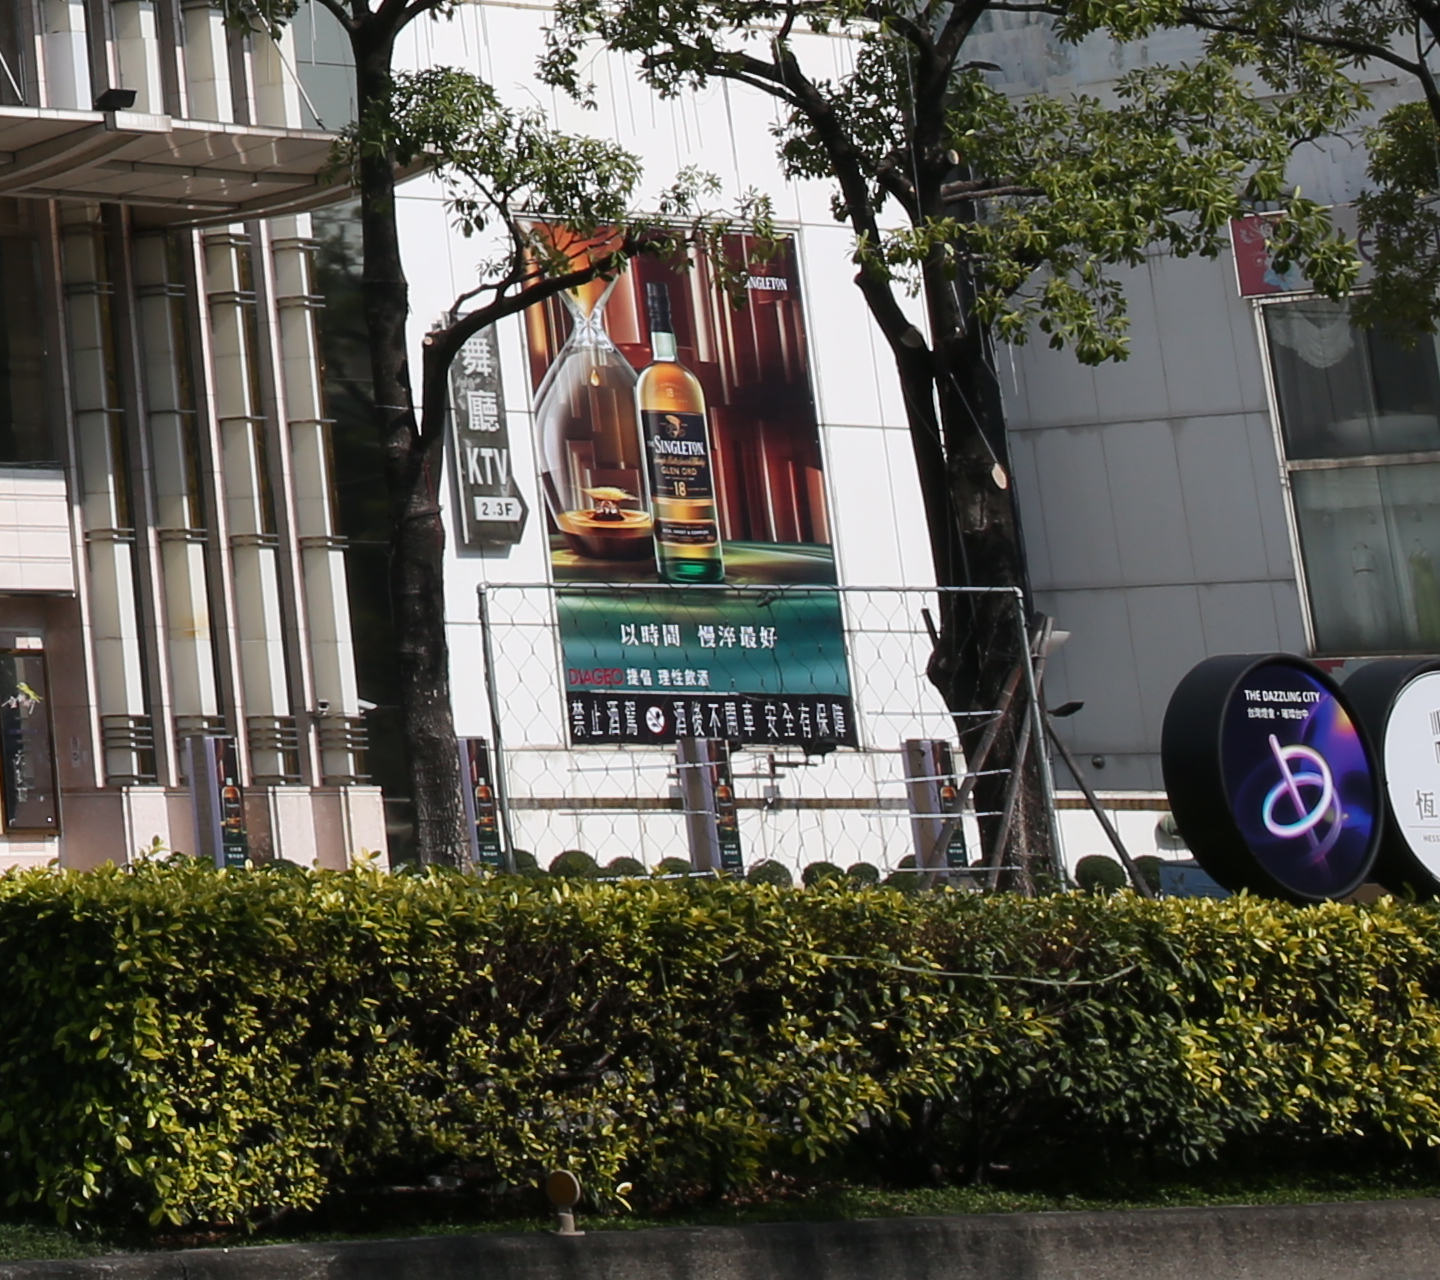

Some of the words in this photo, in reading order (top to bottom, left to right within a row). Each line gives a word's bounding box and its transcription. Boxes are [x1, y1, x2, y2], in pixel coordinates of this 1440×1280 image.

[654, 435, 705, 455] SINGLETON
[466, 447, 508, 485] KTV
[673, 481, 687, 496] 18
[621, 624, 681, 647] 以時間
[569, 668, 624, 685] DIAGEO
[1244, 689, 1261, 701] THE
[1262, 690, 1302, 703] DAZZLING
[1302, 691, 1321, 703] CITY
[571, 699, 639, 736] 禁止酒駕
[764, 701, 847, 739] 安全有保障
